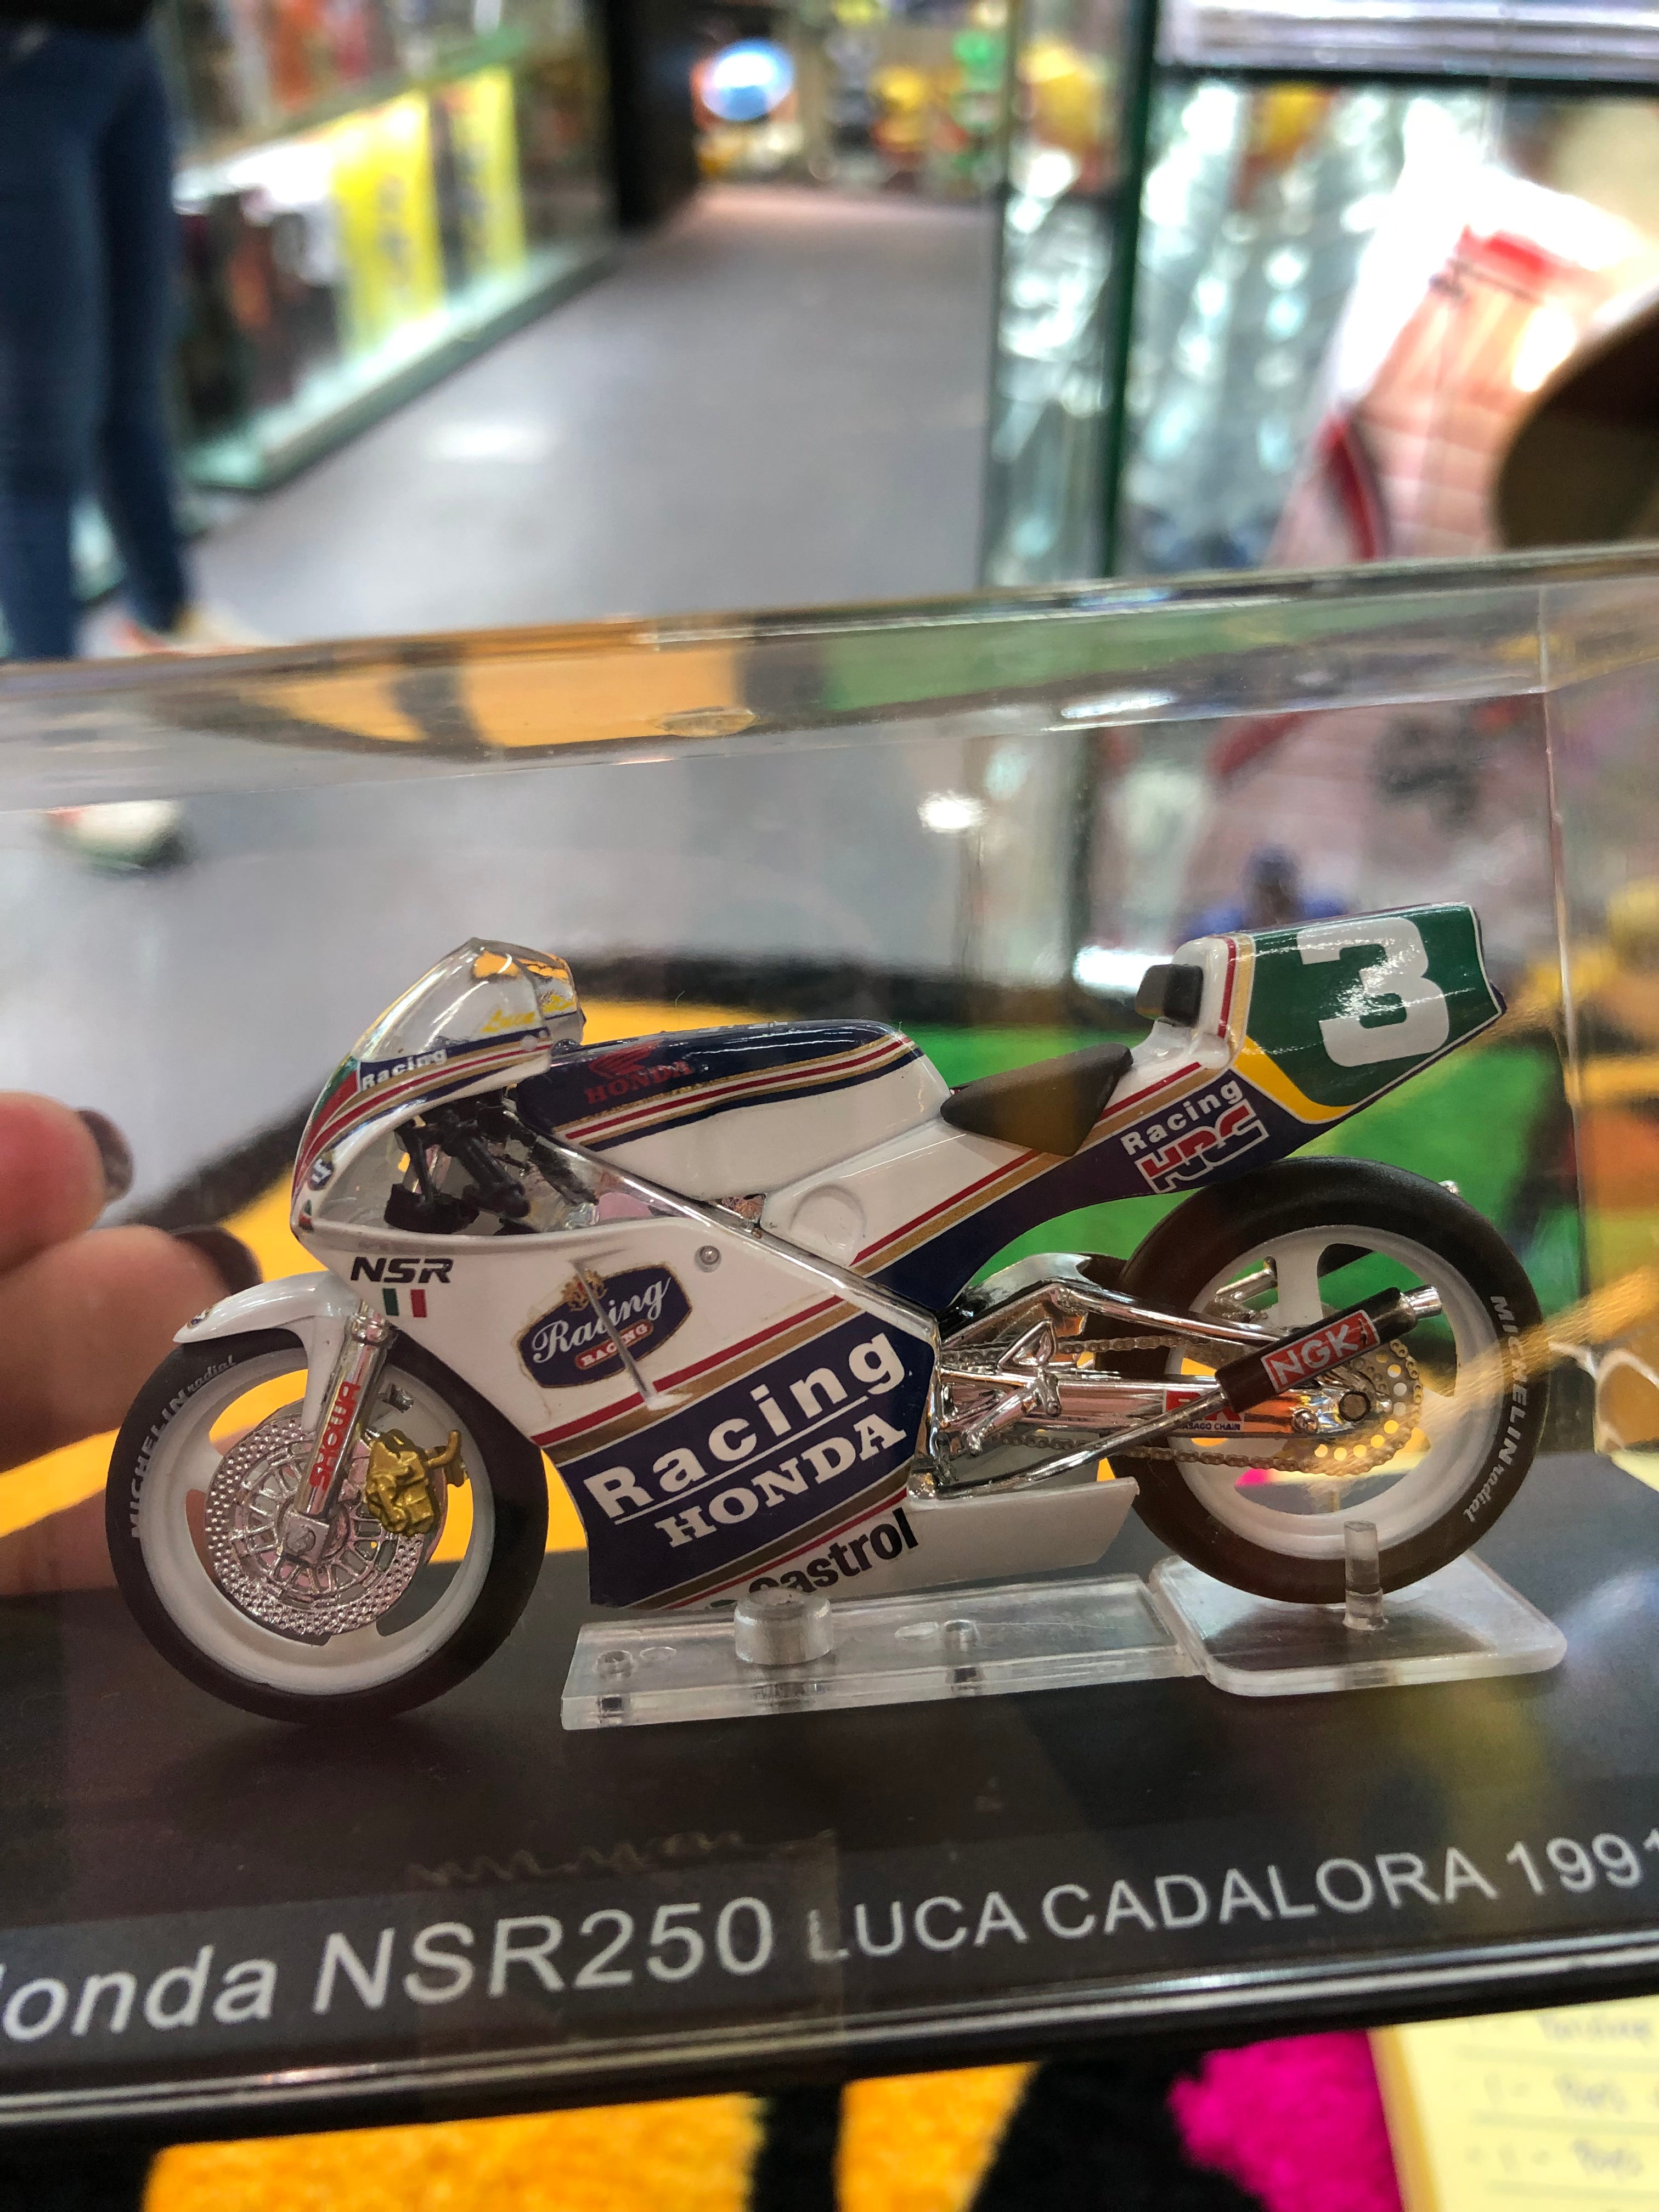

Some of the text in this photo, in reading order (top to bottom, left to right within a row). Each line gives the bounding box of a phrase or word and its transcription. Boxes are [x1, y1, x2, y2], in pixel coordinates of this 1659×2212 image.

[1296, 917, 1450, 1067] 3
[362, 1049, 448, 1090] Racing
[584, 1060, 693, 1104] HONDA
[1120, 1080, 1243, 1155] Racing
[351, 1256, 454, 1283] NSR
[580, 1323, 648, 1367] RACNG
[1270, 1324, 1358, 1385] NGK
[129, 1354, 236, 1538] MICHELIN radial
[309, 1381, 362, 1491] SHOWA
[584, 1333, 906, 1519] Racing
[1463, 1296, 1527, 1523] MICHELIN radial
[655, 1413, 907, 1548] HONDA
[0, 1944, 278, 2042] onda
[313, 1897, 770, 2015] NSR250
[808, 1891, 1028, 1962] LUCA
[1041, 1847, 1499, 1940] CADALORA
